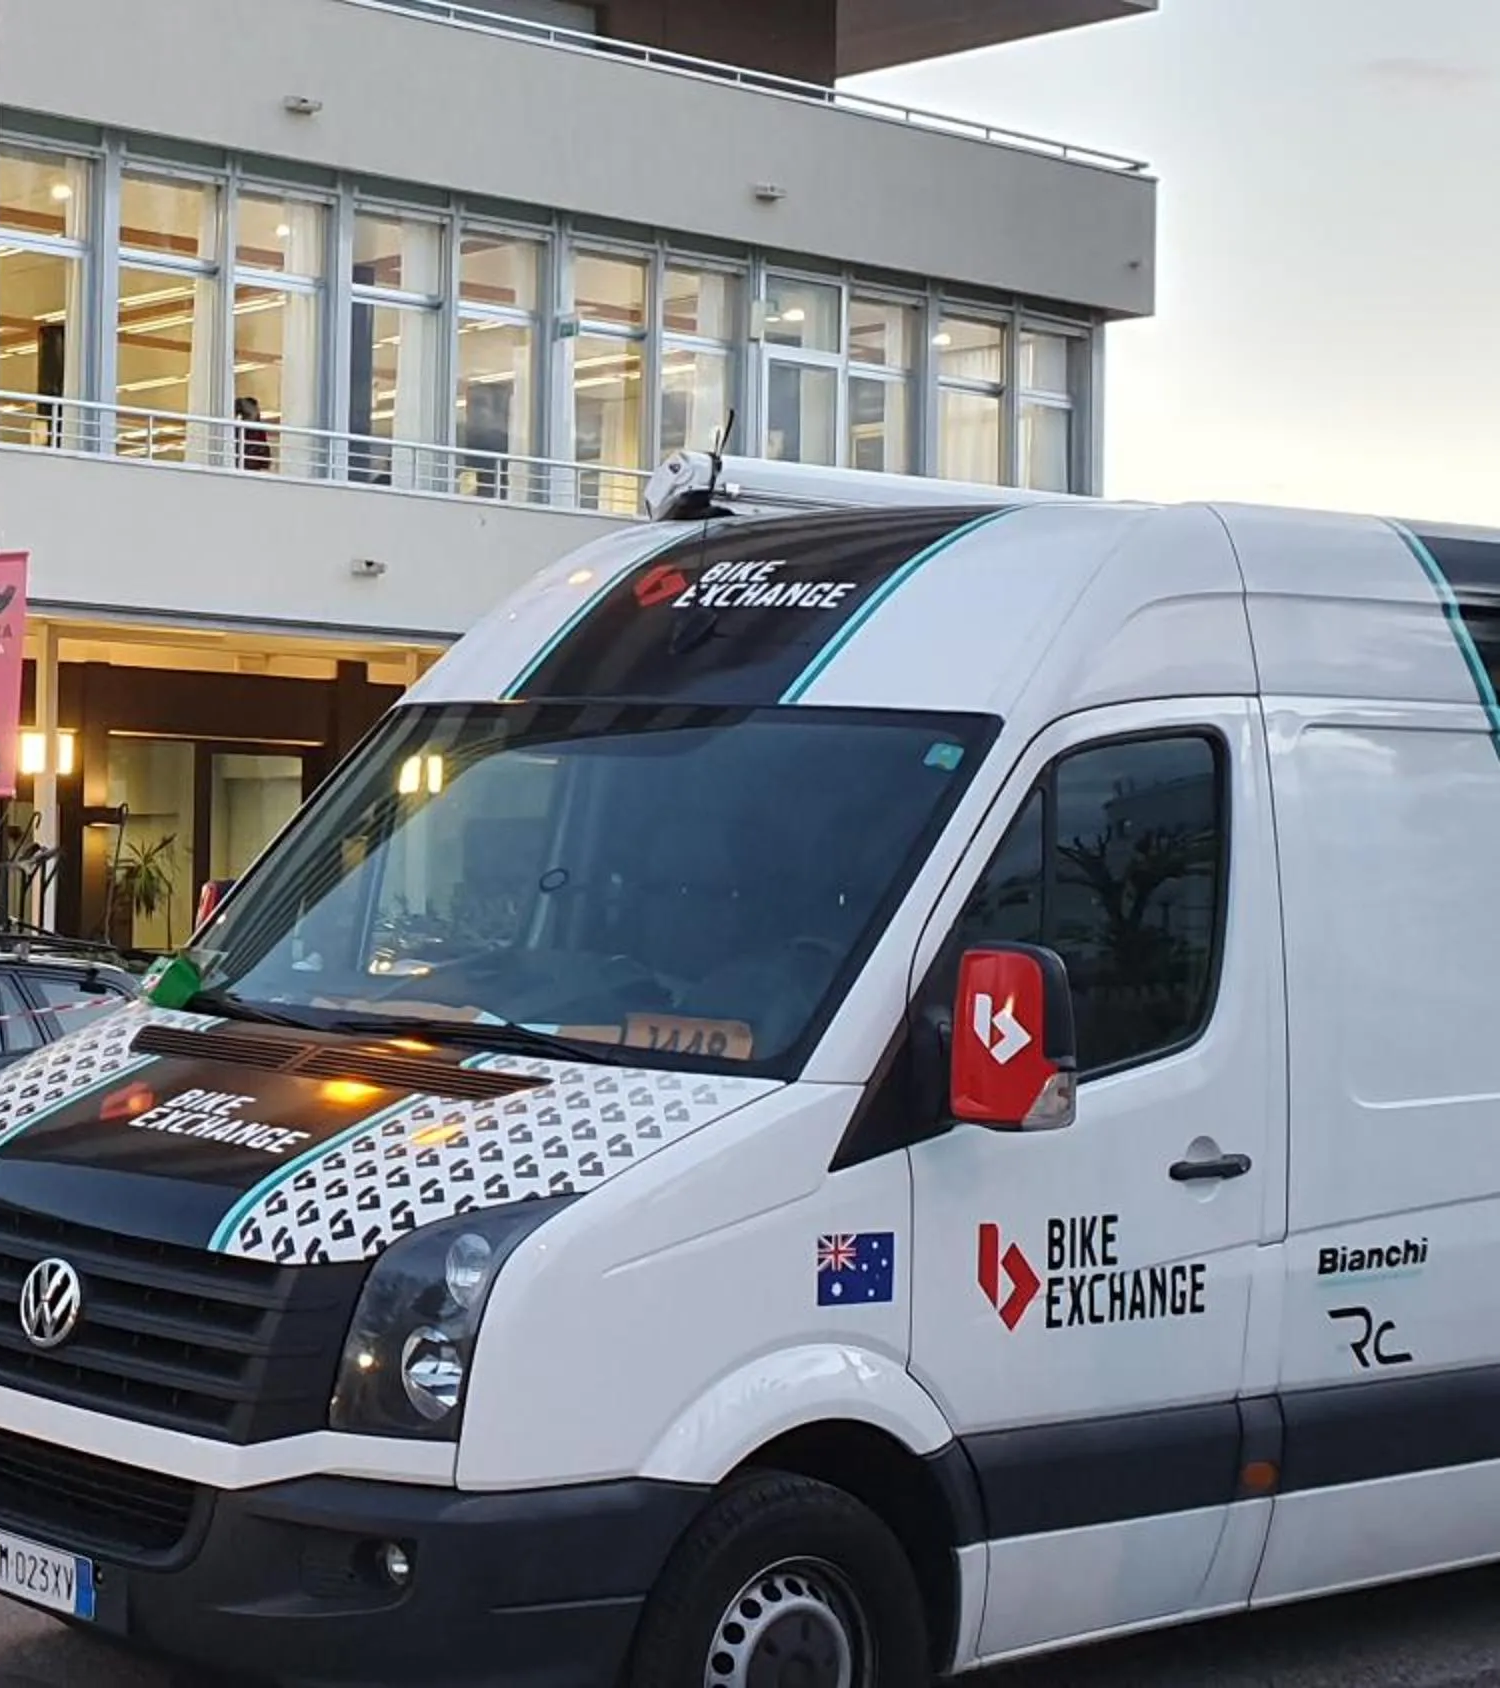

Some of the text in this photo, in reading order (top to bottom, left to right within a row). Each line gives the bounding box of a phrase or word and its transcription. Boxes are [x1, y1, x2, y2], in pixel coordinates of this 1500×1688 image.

[700, 559, 787, 583] BIKE
[672, 582, 856, 609] EXCHANGE
[162, 1088, 257, 1117] BIKE
[128, 1106, 310, 1155] EXCHANGE
[1046, 1213, 1119, 1271] BIKE
[1317, 1237, 1429, 1275] Bianchi
[1045, 1263, 1207, 1329] EXCHANGE
